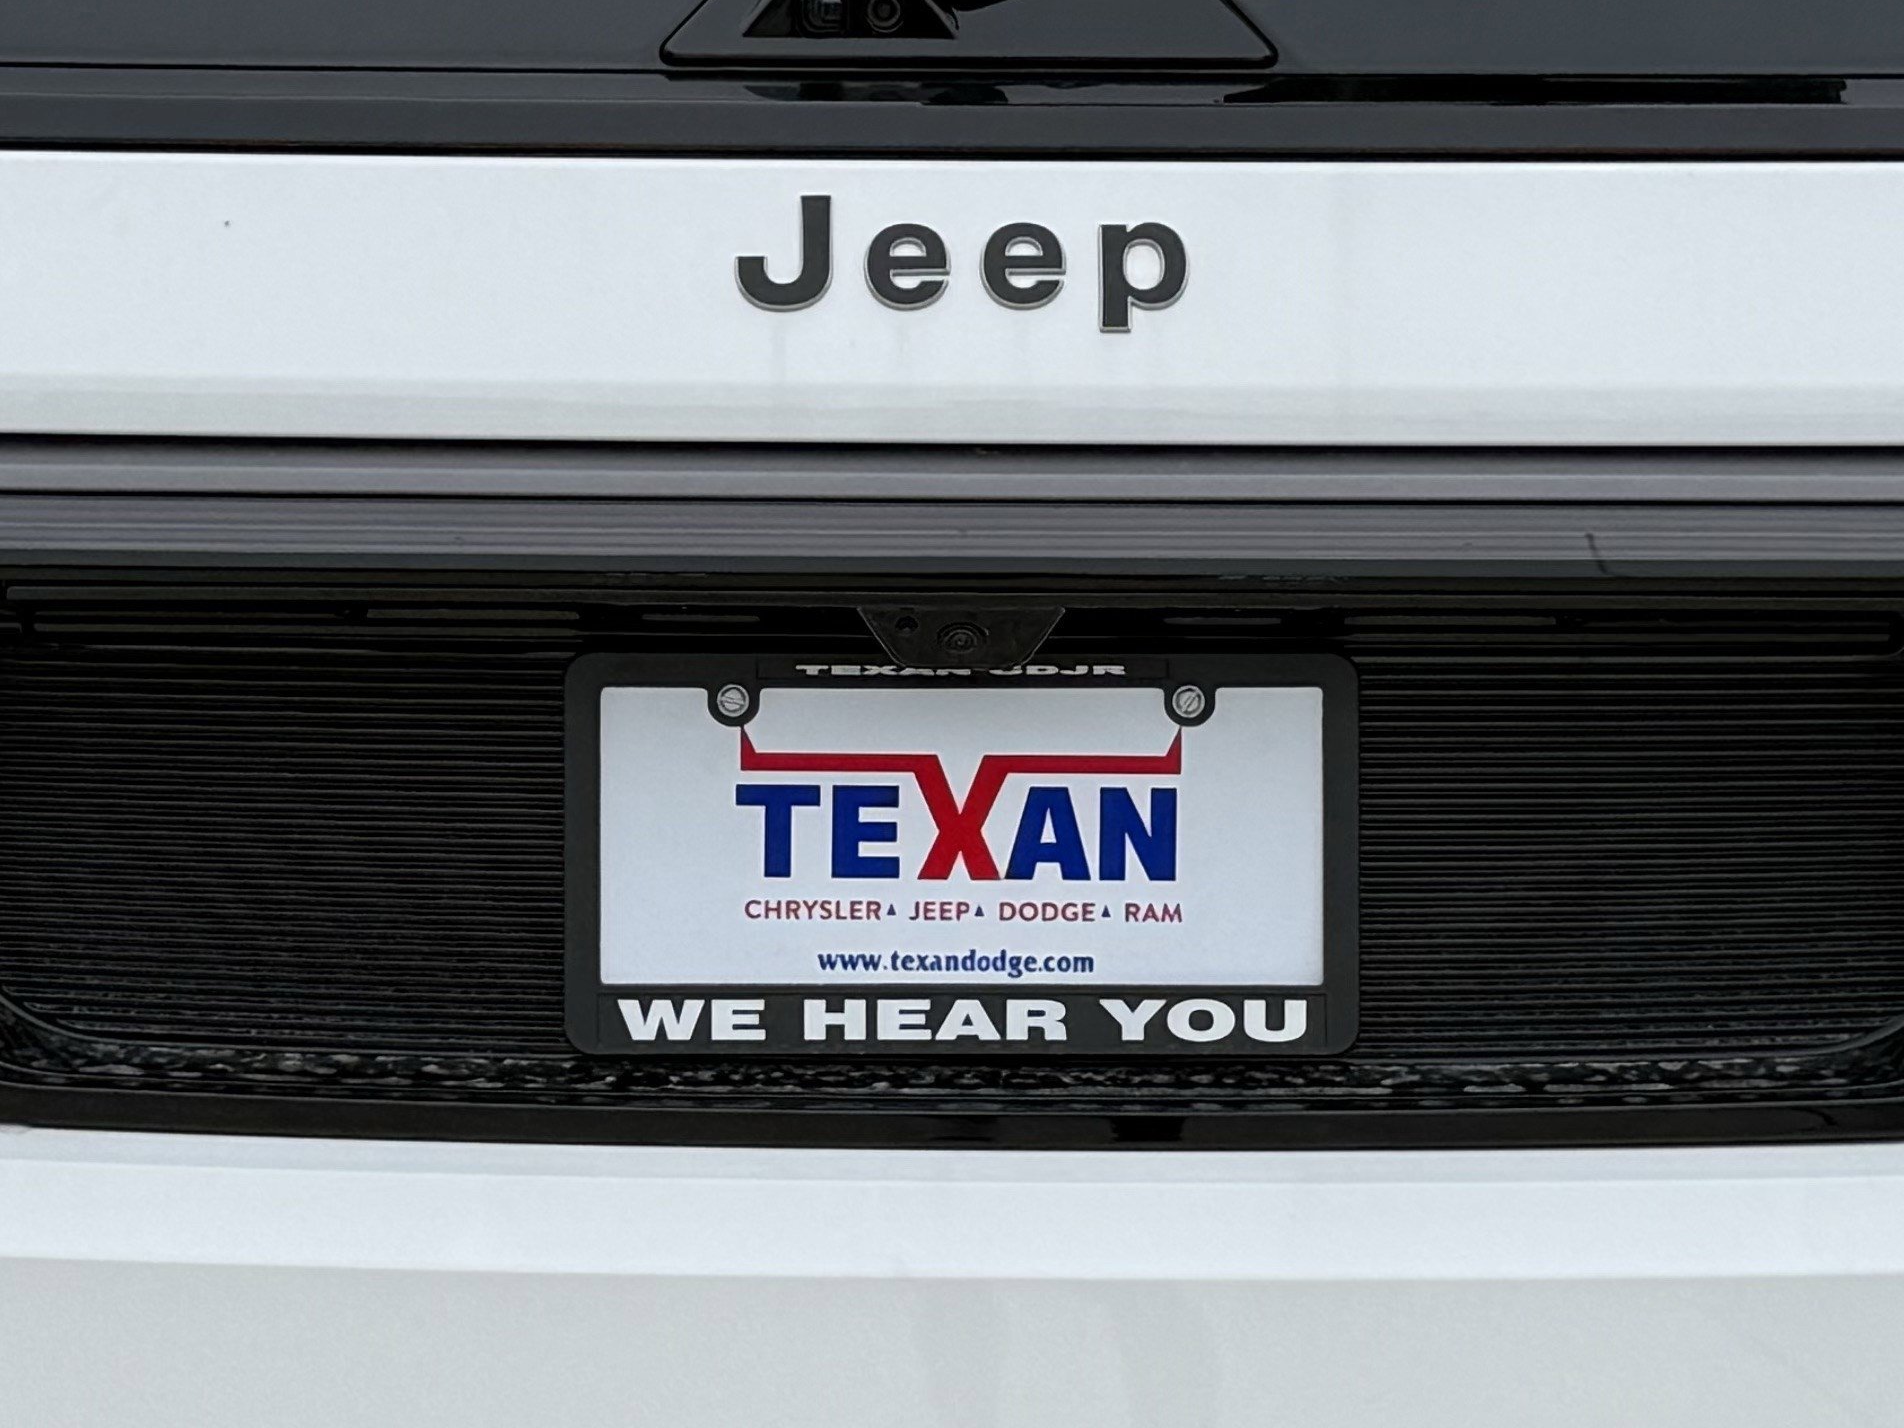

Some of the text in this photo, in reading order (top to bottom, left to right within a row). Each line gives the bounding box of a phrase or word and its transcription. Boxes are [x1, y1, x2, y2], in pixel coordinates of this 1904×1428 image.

[734, 194, 1191, 333] Jeep
[734, 753, 1181, 882] TEXAN
[744, 899, 1183, 924] CHRYSLER JEEP DODGE RAM
[817, 948, 1095, 979] www.texandodge.com
[617, 997, 1308, 1043] WE HEAR YOU
